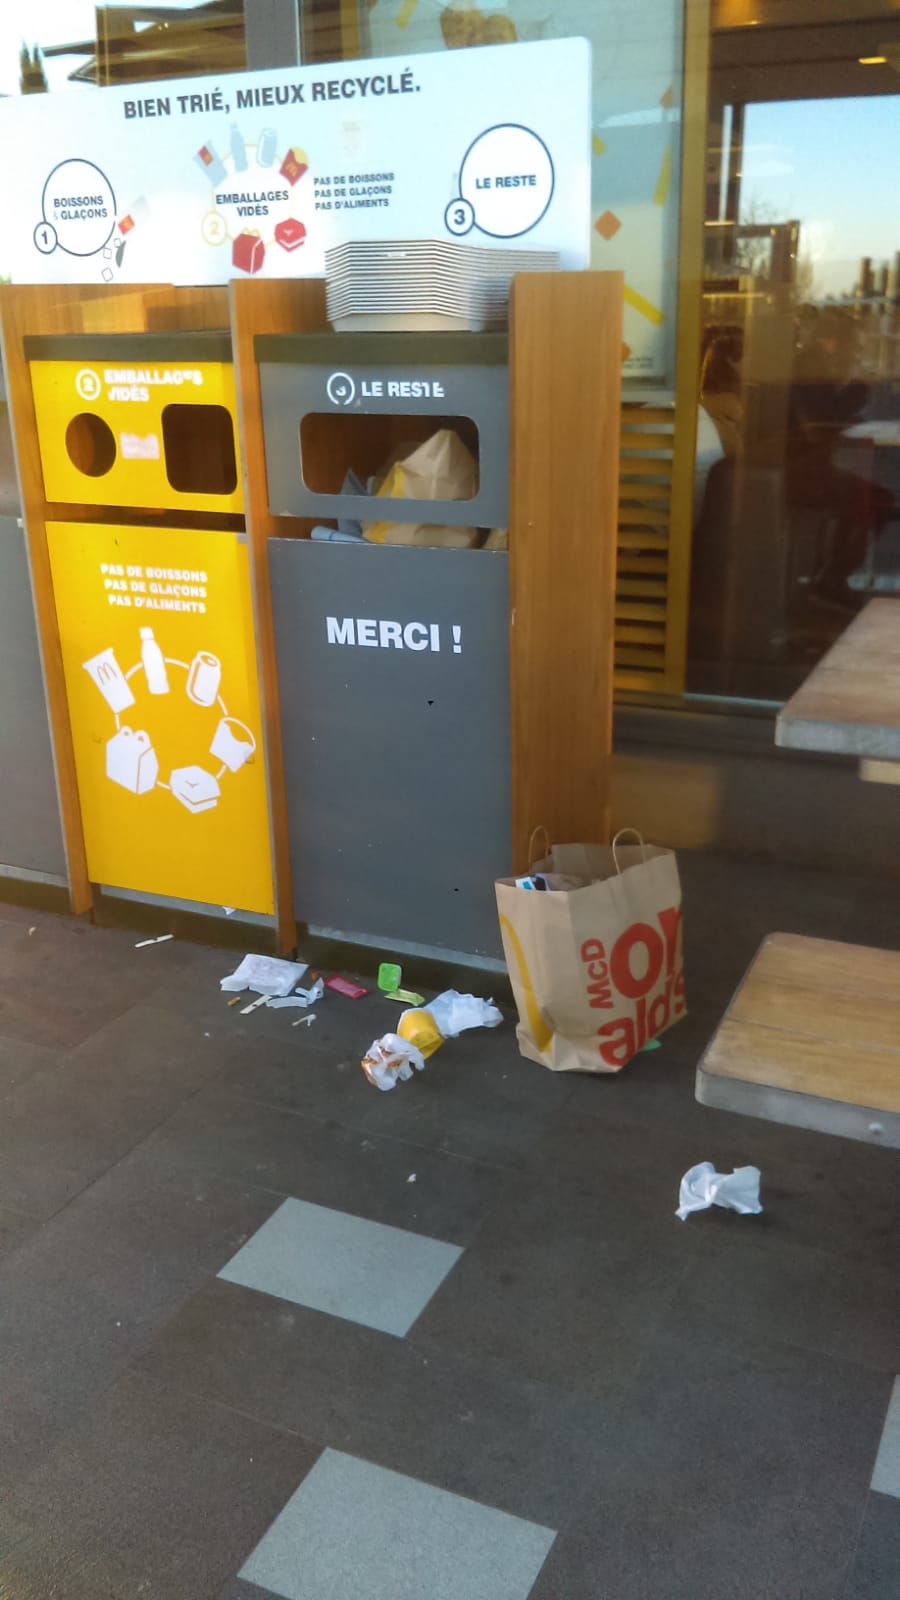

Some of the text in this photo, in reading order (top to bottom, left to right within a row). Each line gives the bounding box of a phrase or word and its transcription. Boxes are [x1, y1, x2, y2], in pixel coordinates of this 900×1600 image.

[123, 67, 421, 119] BIEN TRIÉ, MIEUX RECYCLÉ.
[313, 172, 395, 186] PAS DE BOISSONS
[475, 175, 537, 189] LE RESTE
[216, 190, 289, 205] EMBALLAGES
[314, 185, 392, 198] PAS DE GLAÇONS
[53, 195, 104, 208] BOISSONS
[315, 198, 389, 211] PAS D'ALIMENTS
[60, 208, 108, 221] GLAÇONS
[236, 203, 269, 217] VIDÉS
[453, 209, 466, 225] 3
[209, 221, 219, 235] 2
[41, 230, 48, 245] 1
[83, 377, 95, 392] 2
[361, 381, 445, 398] LE RESTE
[100, 563, 208, 583] PAS DE BOISSONS
[104, 578, 207, 598] PAS DE GLAÇONS
[108, 593, 206, 614] PAS D'ALIMENTS
[326, 616, 462, 653] MERCI !
